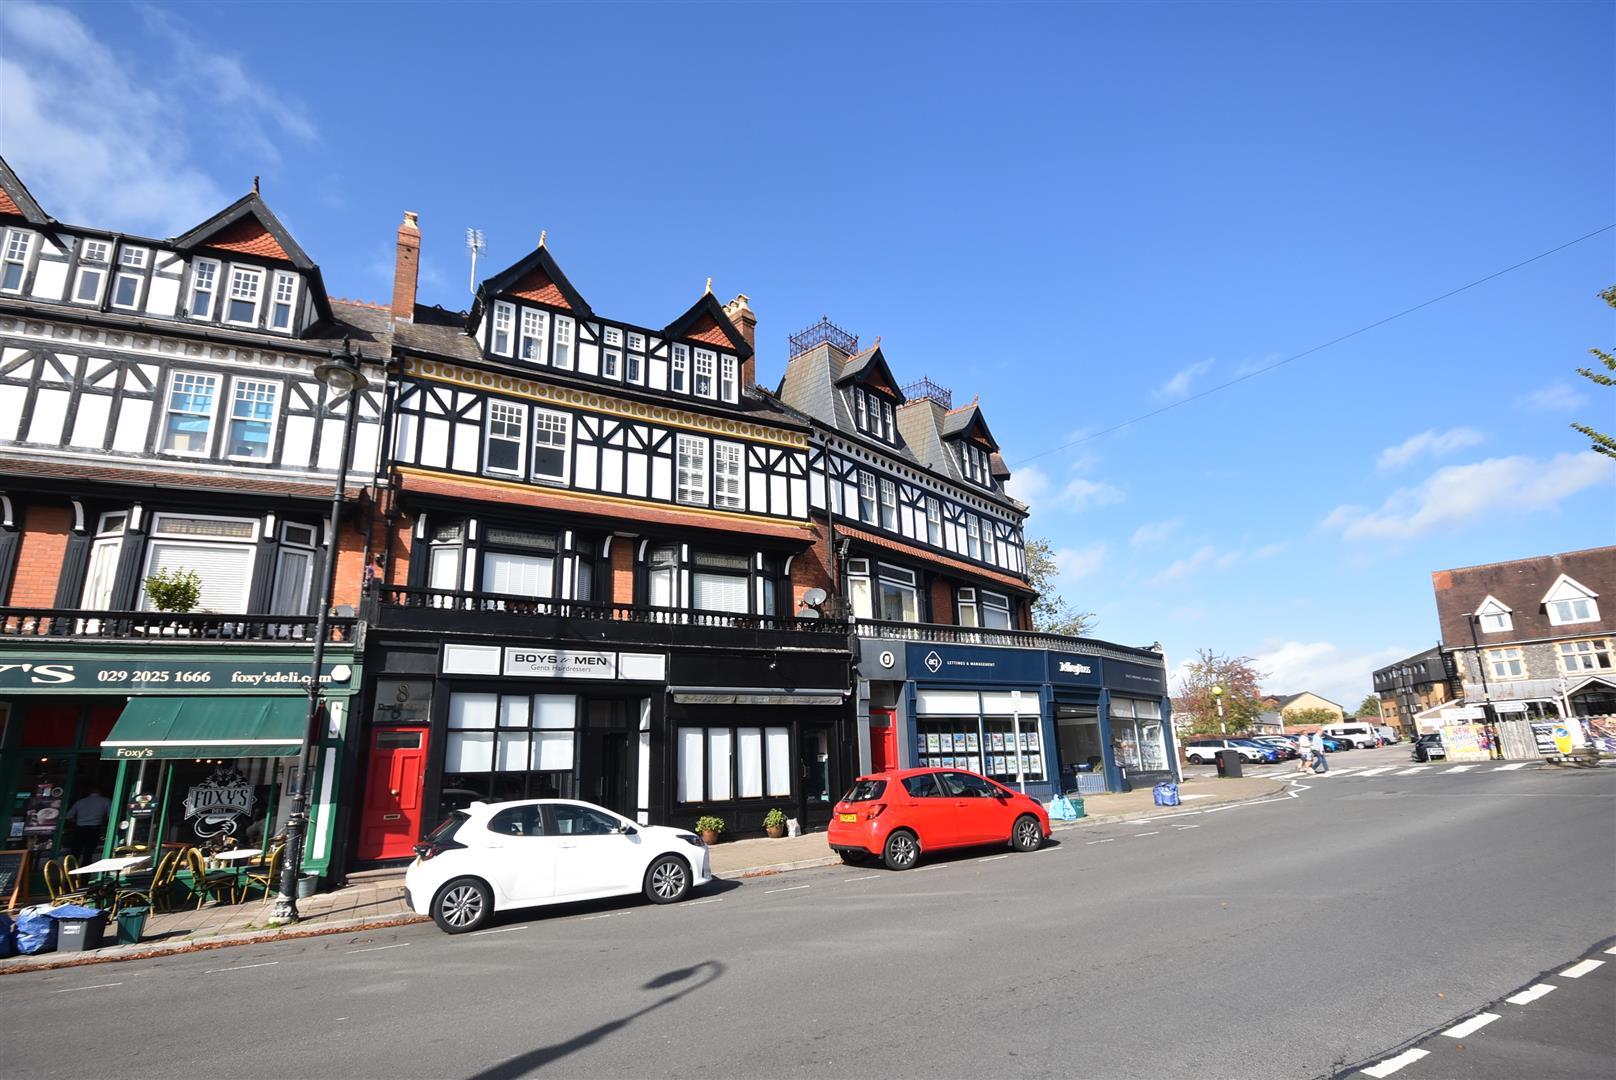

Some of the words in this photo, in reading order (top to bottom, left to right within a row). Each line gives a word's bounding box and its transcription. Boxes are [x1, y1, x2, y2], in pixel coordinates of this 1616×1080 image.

[514, 653, 558, 664] BOYS
[574, 656, 607, 666] MEN
[530, 663, 550, 672] Gents
[551, 664, 592, 673] Hairdressers
[97, 670, 129, 682] 029
[131, 670, 170, 682] 2025
[174, 671, 212, 683] 1666
[231, 670, 333, 686] foxy'sdeli.cm
[116, 747, 154, 759] Foxy's
[194, 789, 249, 808] FOXY'S
